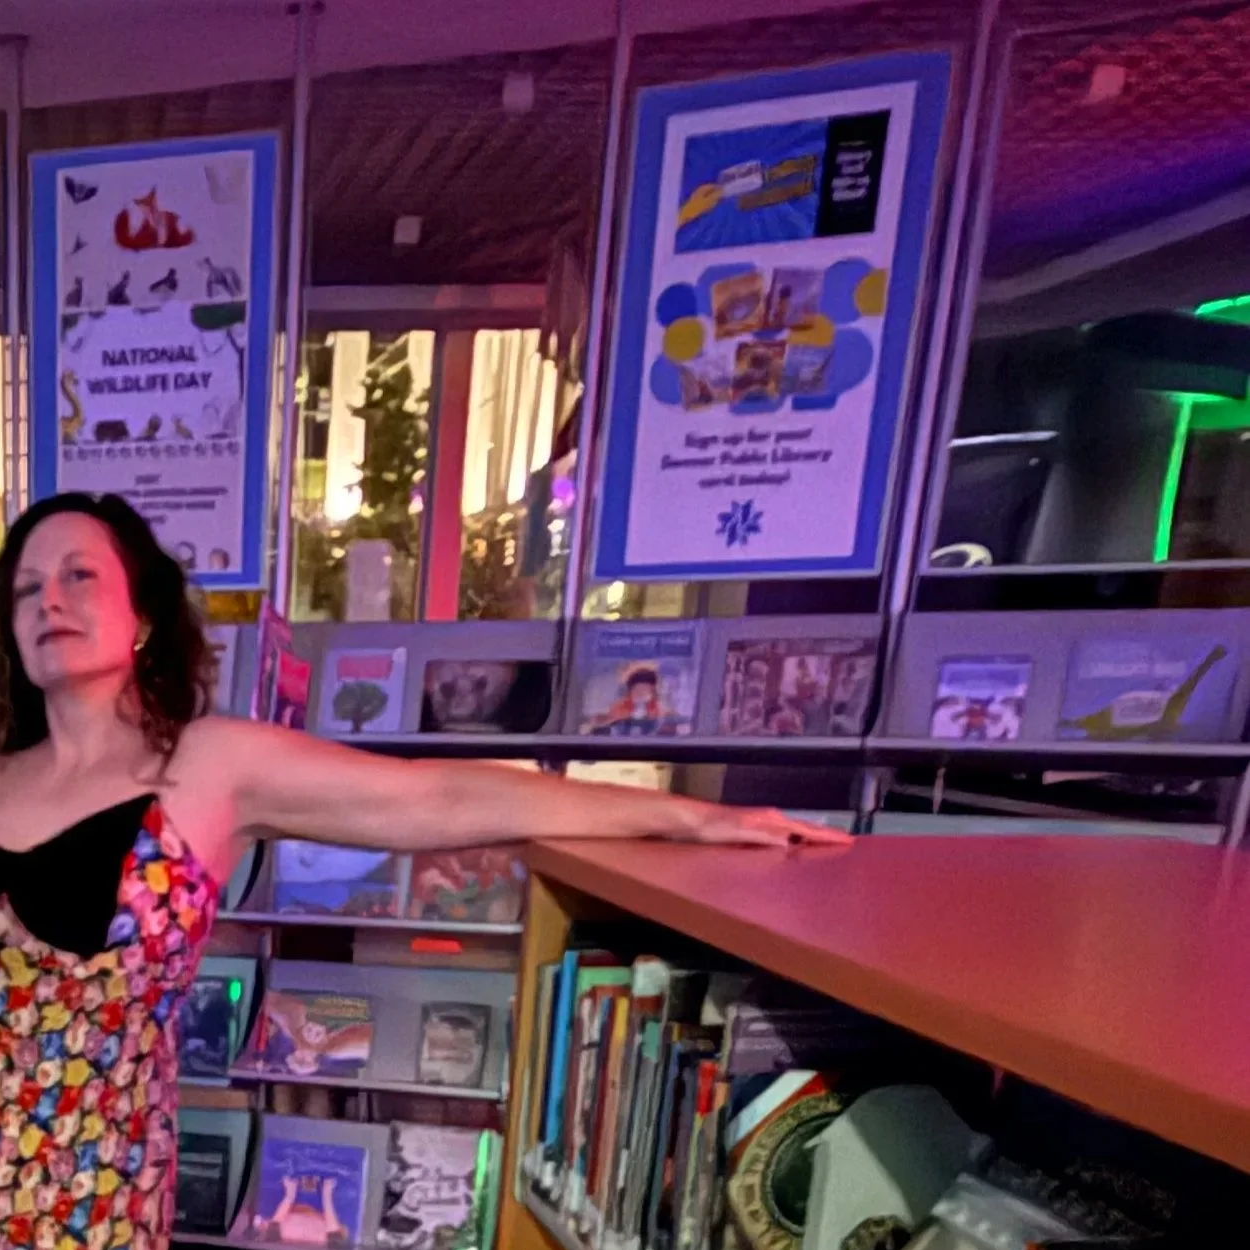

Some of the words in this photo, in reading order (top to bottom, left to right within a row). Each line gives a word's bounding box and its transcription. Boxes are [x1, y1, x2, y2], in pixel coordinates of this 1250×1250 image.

[101, 345, 198, 367] NATIONAL
[86, 373, 170, 395] WILDLIFE
[173, 371, 213, 391] DAY
